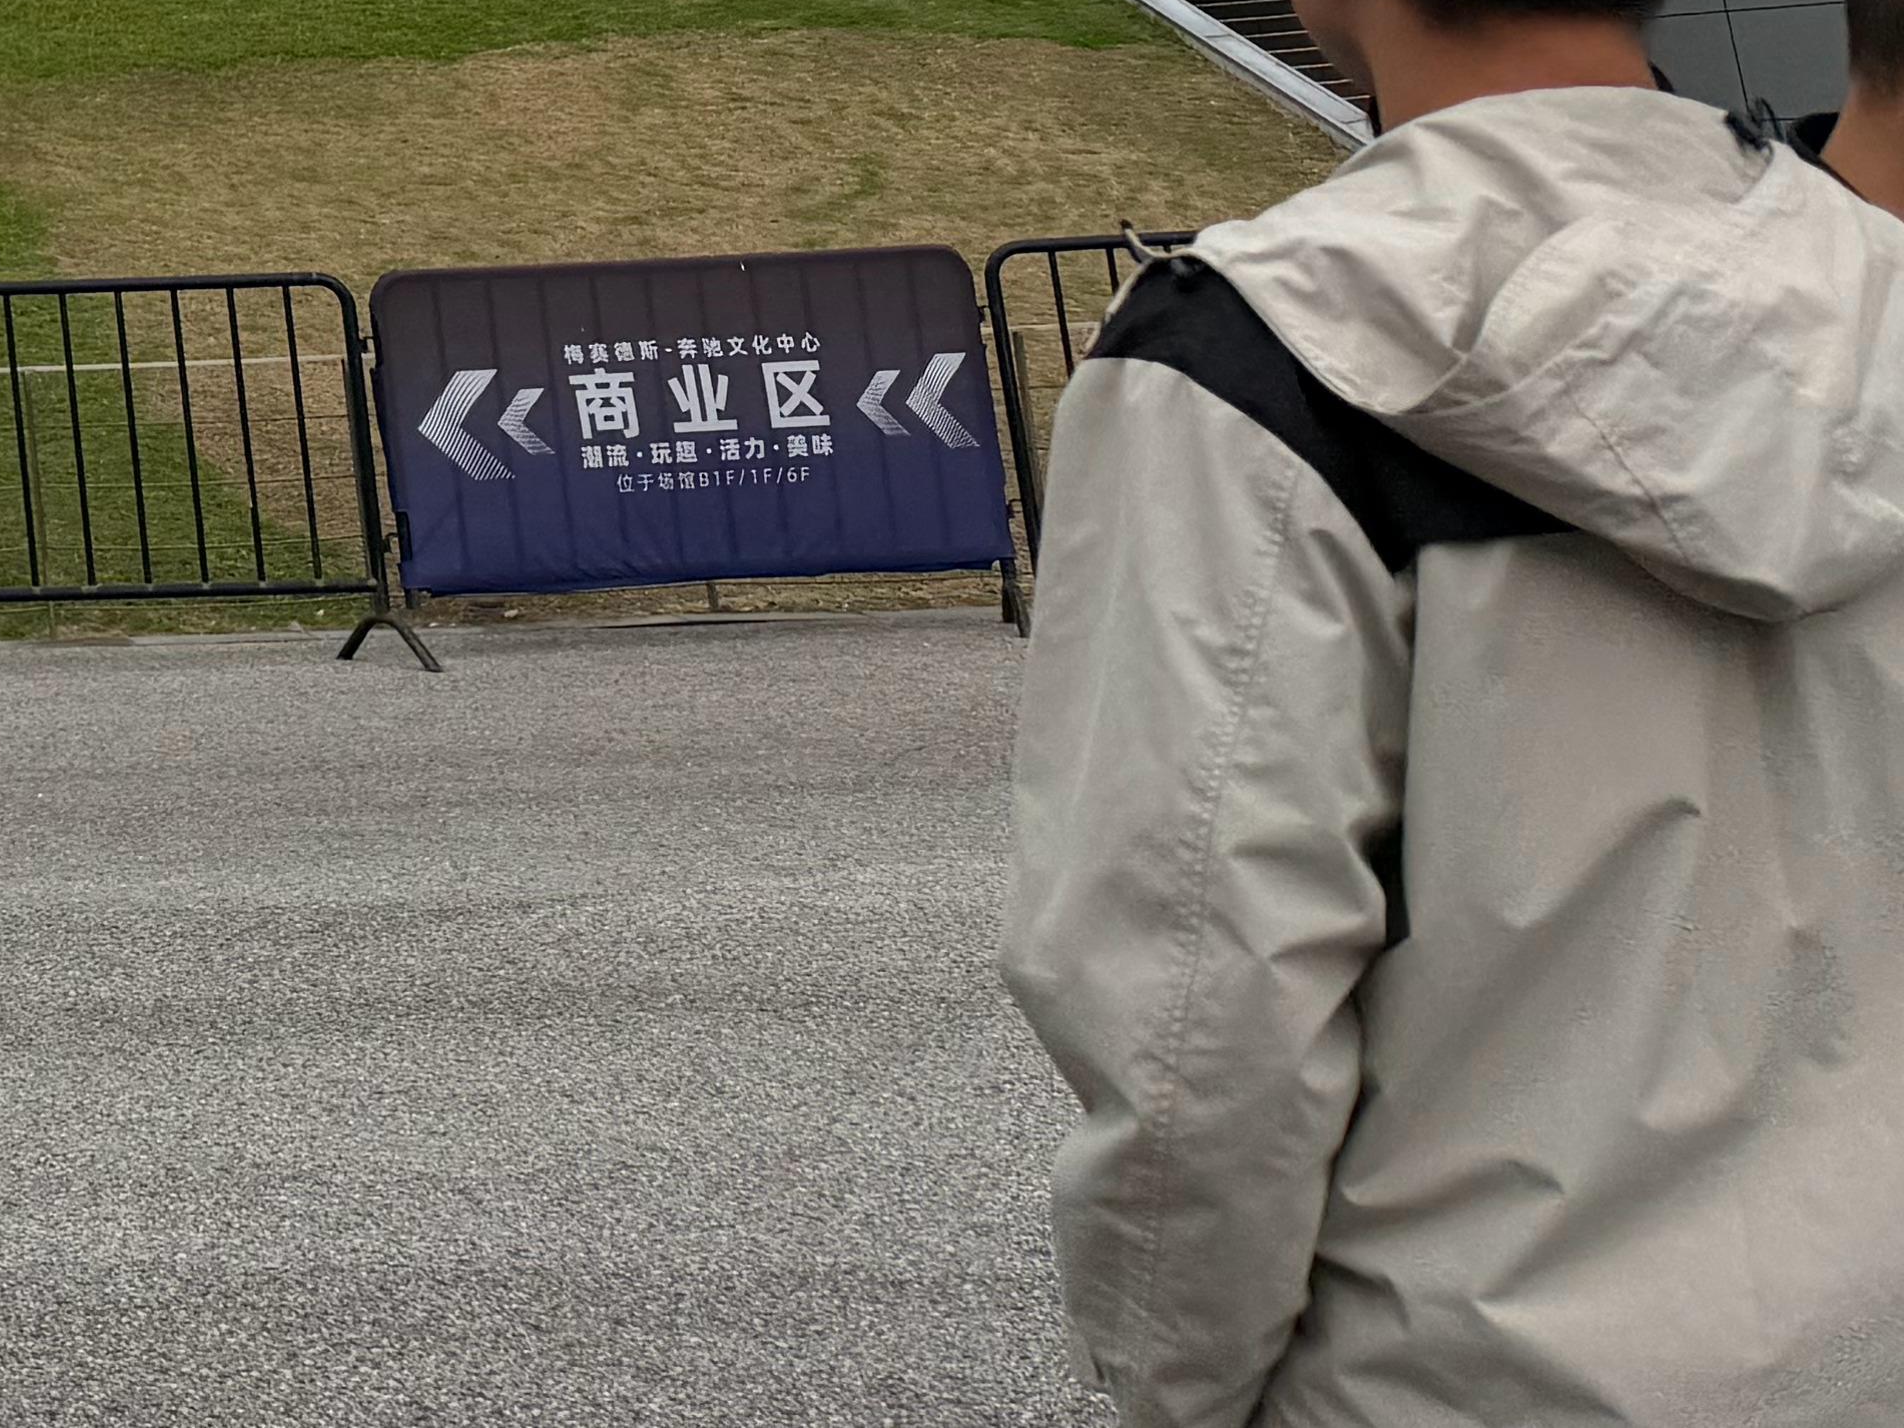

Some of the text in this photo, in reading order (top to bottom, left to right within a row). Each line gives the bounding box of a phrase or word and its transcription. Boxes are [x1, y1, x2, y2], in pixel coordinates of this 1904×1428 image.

[563, 331, 821, 365] 梅赛德斯-奔驰文化中心
[568, 359, 831, 440] 商业区
